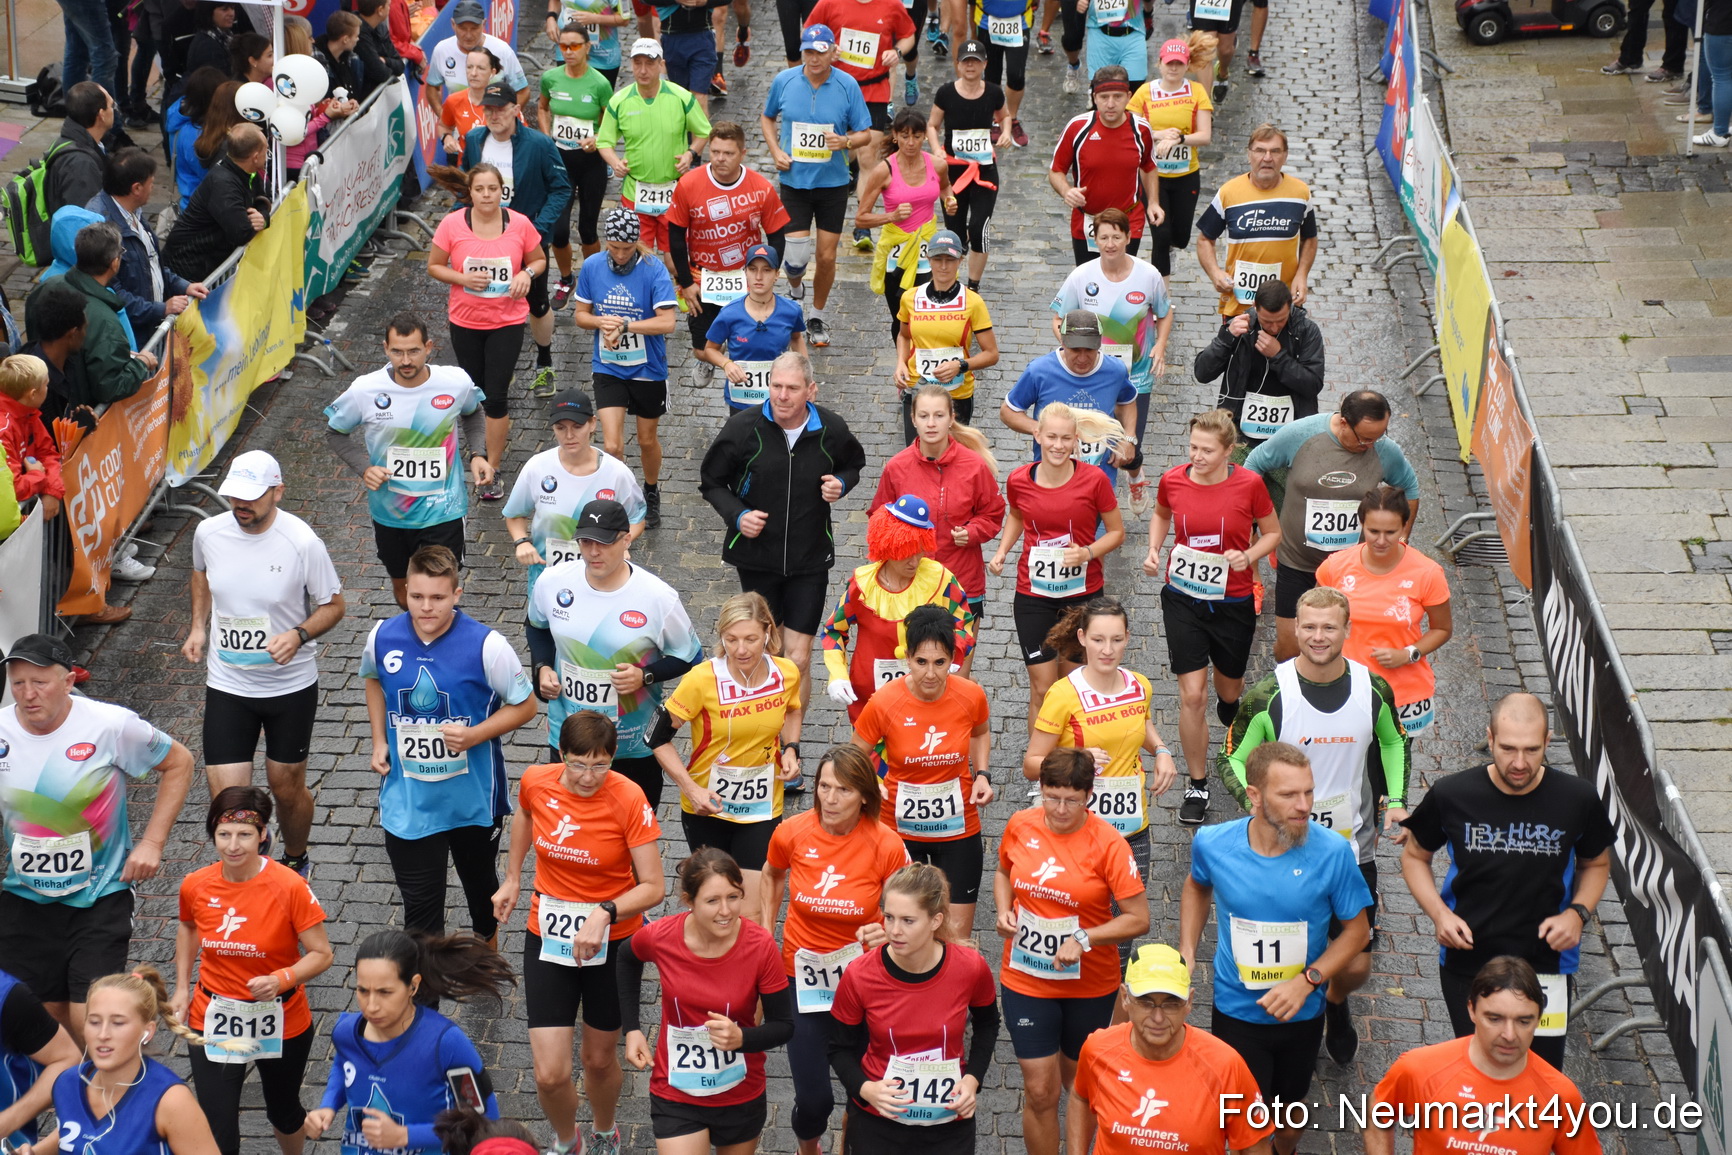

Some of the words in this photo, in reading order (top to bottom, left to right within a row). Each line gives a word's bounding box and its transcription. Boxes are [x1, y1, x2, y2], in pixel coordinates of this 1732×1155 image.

[992, 22, 1019, 35] 2038
[848, 38, 870, 55] 116
[1166, 44, 1186, 54] NIKE
[1151, 101, 1170, 109] MAX
[1173, 98, 1195, 107] BÖGL
[557, 125, 589, 140] 2047
[800, 133, 825, 148] 320
[957, 138, 988, 152] 3057
[799, 150, 825, 159] Wolfgang
[640, 189, 673, 203] 2418
[1246, 216, 1291, 228] Fischer
[1250, 225, 1289, 233] AUTOMOBILE
[706, 277, 743, 291] 2355
[940, 312, 966, 321] BÖGL
[743, 391, 765, 399] Nicole
[1247, 404, 1290, 423] 2387
[1256, 425, 1277, 434] André
[393, 459, 441, 479] 2015
[540, 494, 556, 502] PARTL
[1312, 512, 1359, 532] 2304
[1320, 536, 1347, 545] Johann
[1175, 557, 1223, 584] 2132
[1047, 583, 1068, 592] Elena
[1183, 581, 1208, 594] Kristin
[552, 607, 571, 618] PARTL
[623, 614, 645, 625] Hervis
[220, 628, 268, 650] 3022
[383, 650, 404, 674] 6
[565, 676, 612, 703] 3087
[720, 705, 752, 719] MAX
[756, 697, 785, 713] BÖGL
[1086, 711, 1118, 726] MAX
[1120, 705, 1146, 719] BÖGL
[1314, 736, 1357, 745] KLEBL
[69, 745, 93, 758] Hervis
[904, 752, 960, 765] funrunners
[921, 755, 965, 767] neumarkt
[419, 764, 448, 774] Daniel
[716, 778, 768, 801] 2755
[925, 785, 955, 795] BOCK
[1109, 779, 1138, 788] BOCK
[727, 804, 750, 814] Petra
[903, 794, 956, 820] 2531
[1087, 791, 1137, 816] 2683
[914, 822, 948, 832] Claudia
[1508, 822, 1566, 841] HiRo
[46, 836, 83, 848] BOCK
[536, 836, 590, 857] funrunners
[1508, 838, 1536, 848] Run
[20, 849, 85, 874] 2202
[548, 851, 599, 866] neumarkt
[34, 877, 72, 889] Richard
[1014, 878, 1071, 900] funrunners
[795, 892, 855, 907] funrunners
[1029, 891, 1079, 908] neumarkt
[810, 905, 864, 915] neumarkt
[1039, 920, 1072, 930] BOCK
[1263, 925, 1300, 934] BOCK
[202, 937, 257, 951] funrunners
[216, 949, 267, 959] neumarkt
[823, 945, 856, 963] BOCK
[1252, 939, 1280, 964] 11
[1251, 970, 1284, 981] Maher
[240, 1002, 276, 1012] BOCK
[213, 1012, 276, 1038] 2613
[920, 1063, 956, 1072] BOCK
[701, 1076, 716, 1087] Evi
[906, 1109, 933, 1119] Julia
[59, 1121, 81, 1152] 2
[1112, 1121, 1179, 1142] funrunners
[1130, 1135, 1189, 1152] neumarkt
[1447, 1137, 1518, 1155] funrunners
